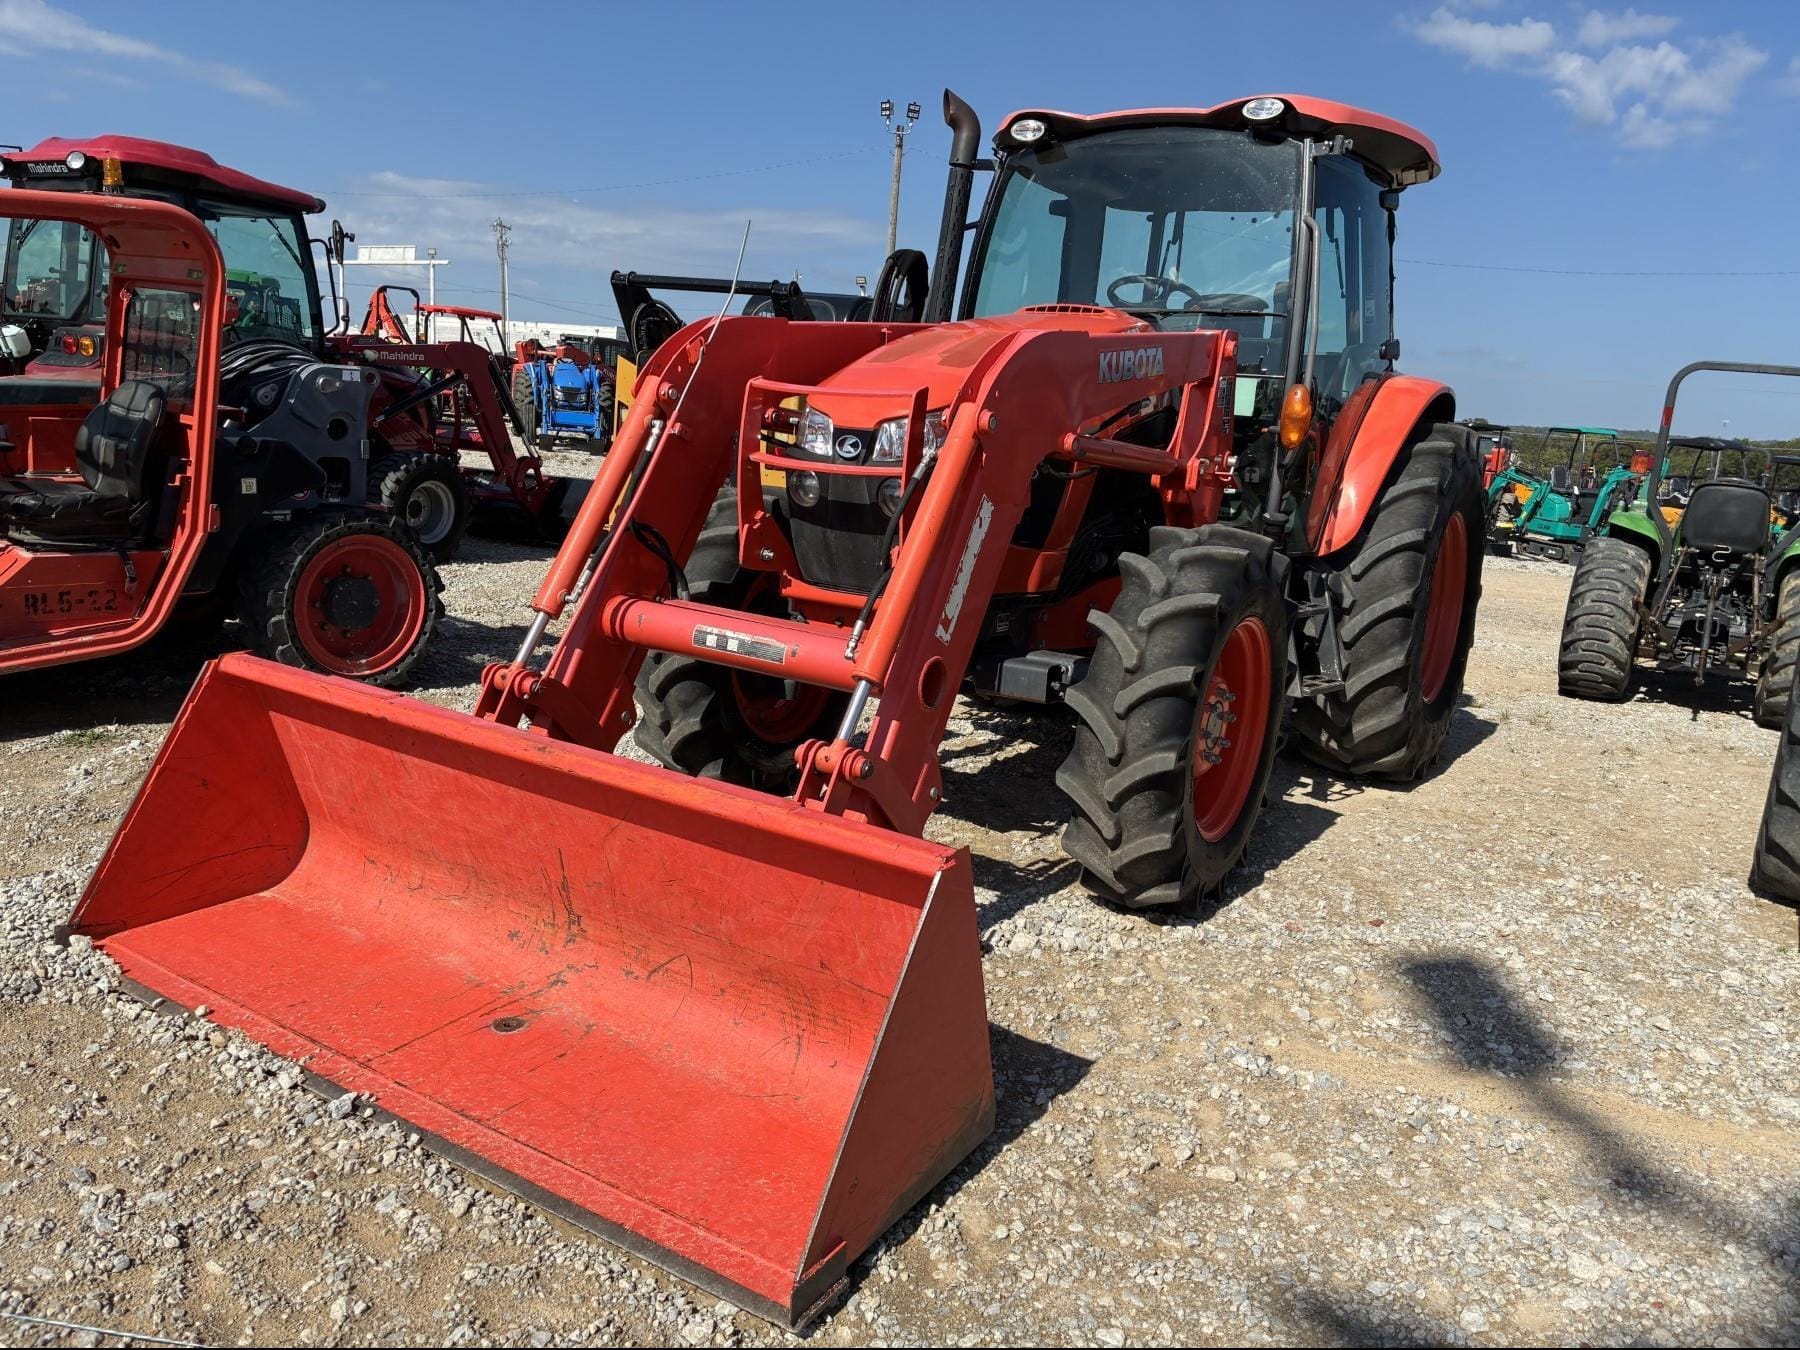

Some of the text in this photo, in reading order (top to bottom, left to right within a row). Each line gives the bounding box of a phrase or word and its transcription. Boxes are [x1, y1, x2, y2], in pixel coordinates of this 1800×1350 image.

[27, 163, 69, 173] Mahindra
[380, 351, 425, 361] Mahindra
[1098, 347, 1165, 384] KUBOTA
